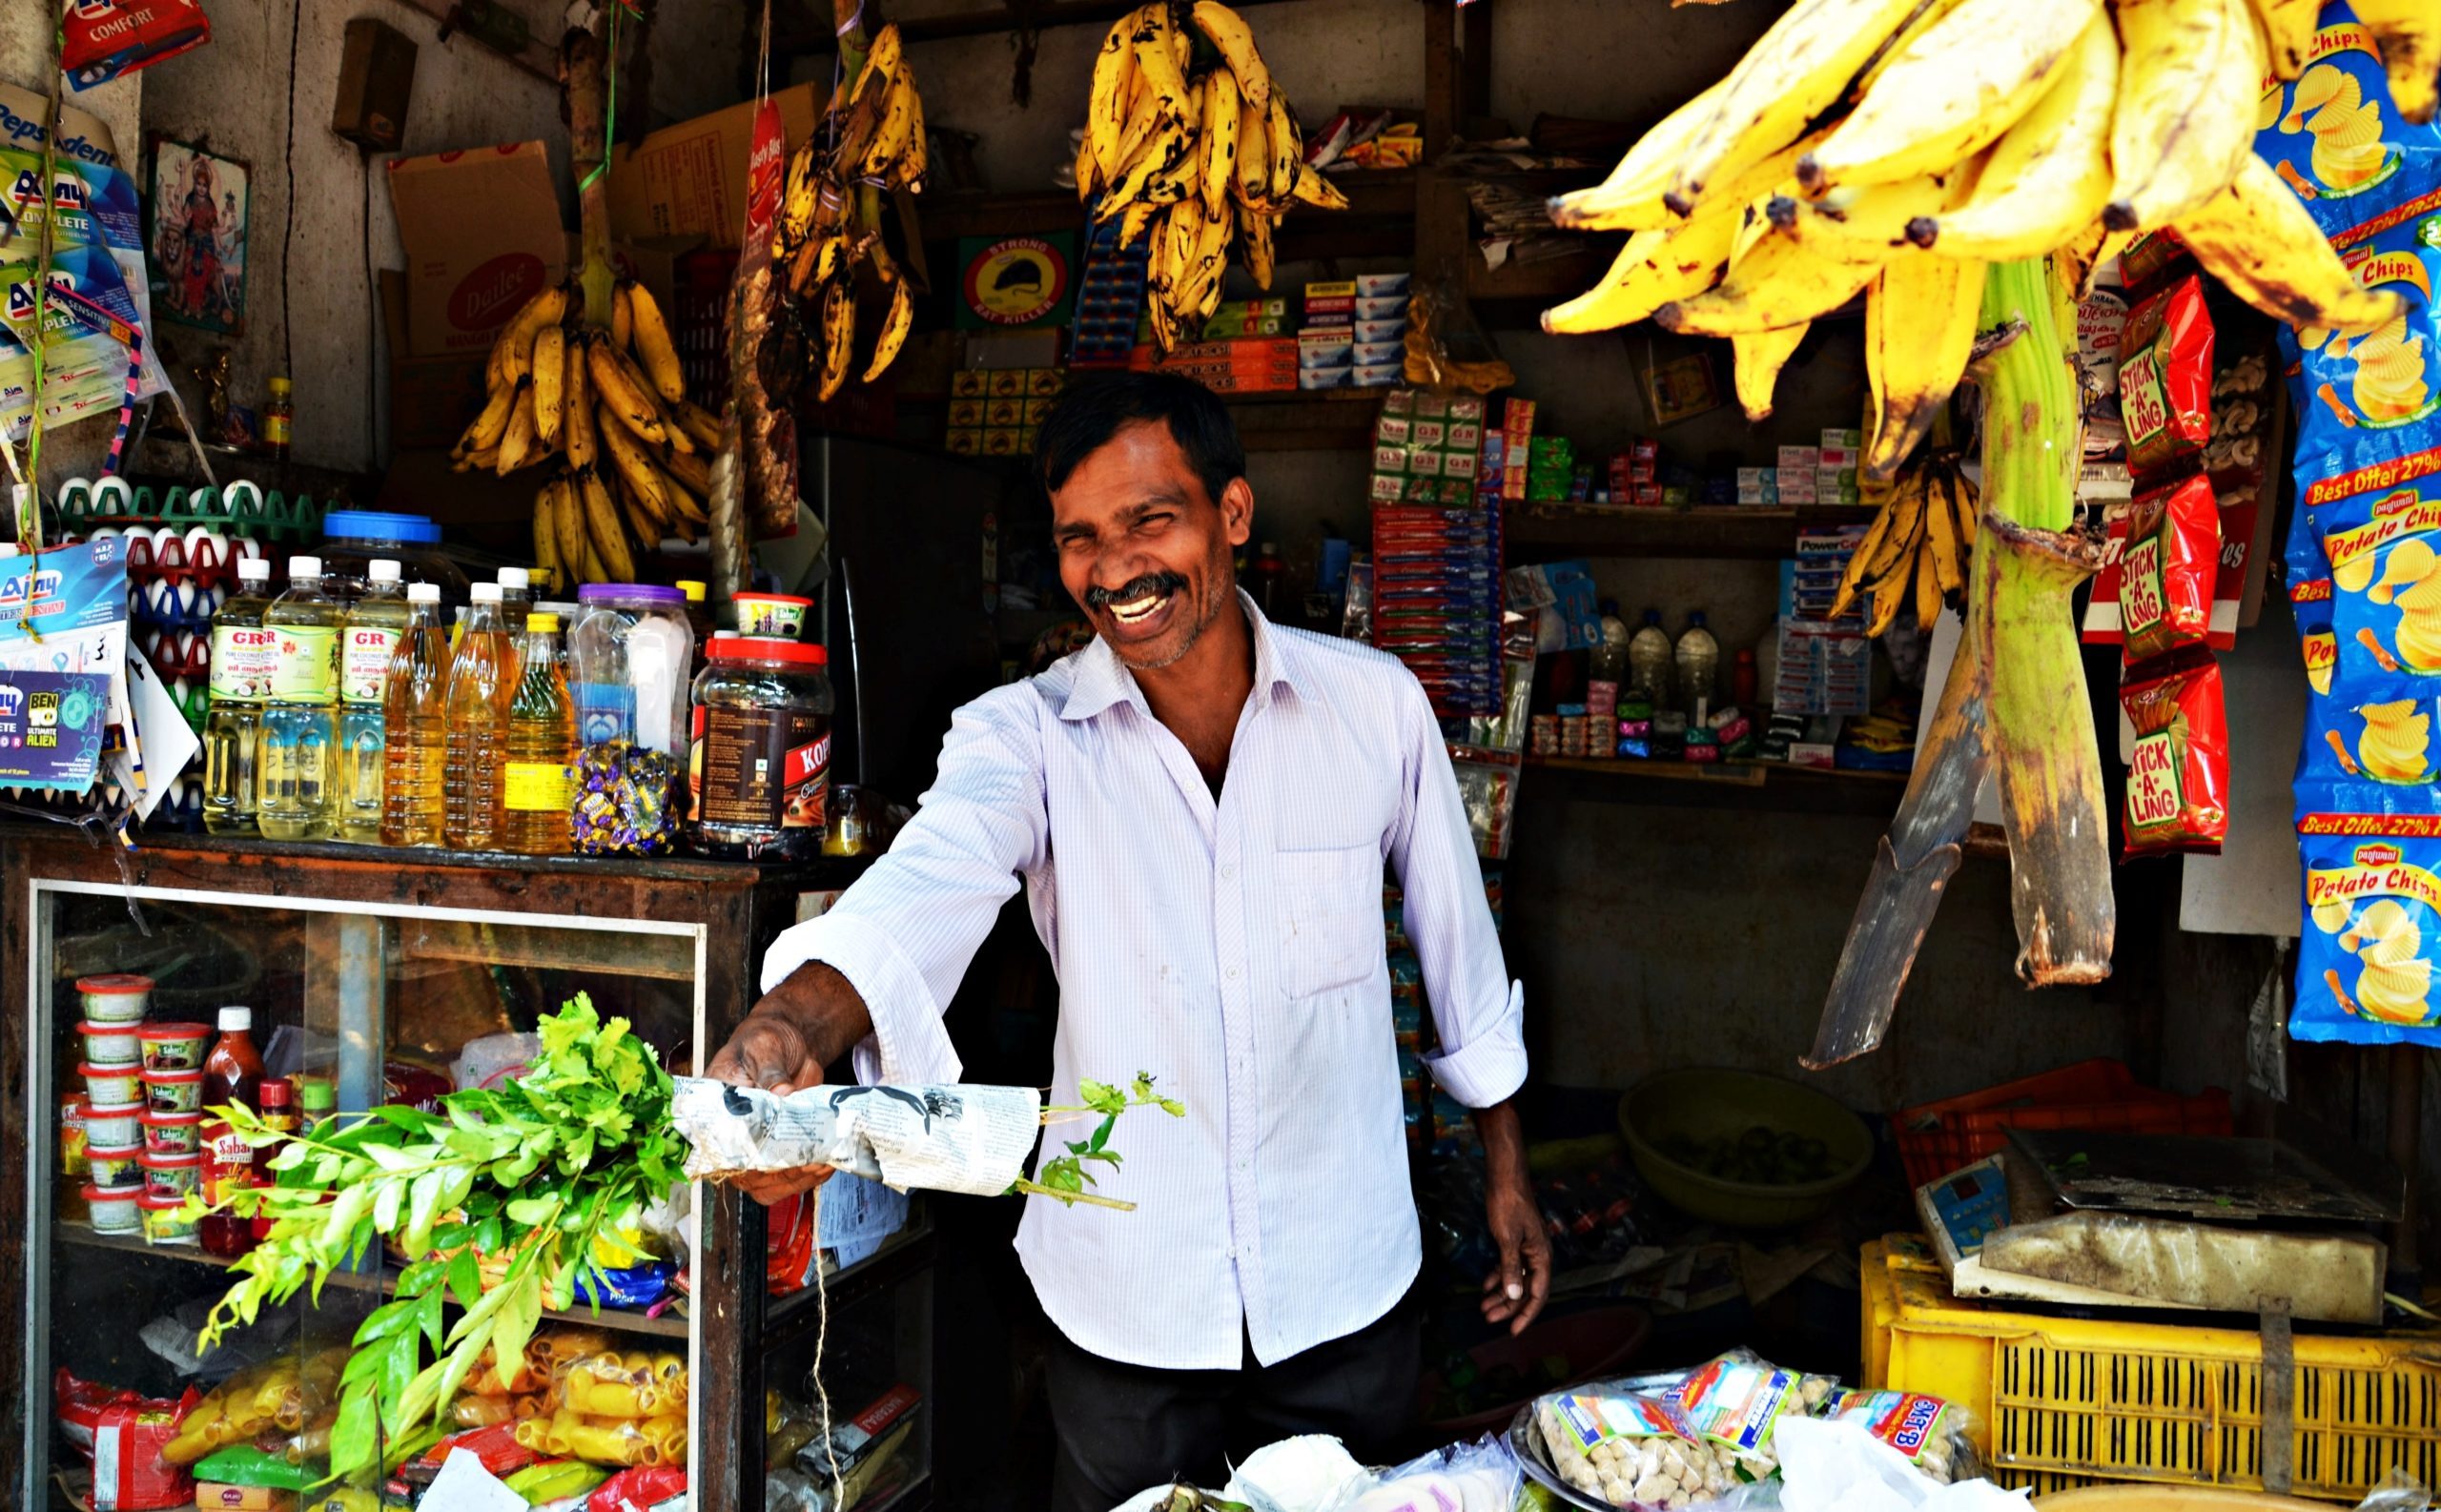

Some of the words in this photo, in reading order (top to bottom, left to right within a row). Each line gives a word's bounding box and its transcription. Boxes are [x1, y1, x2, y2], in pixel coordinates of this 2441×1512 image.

[89, 8, 155, 43] COMFORT
[0, 103, 115, 167] Pepsdent
[988, 237, 1050, 256] STRONG
[2363, 258, 2413, 284] Chips
[68, 297, 112, 327] SENSITIVE
[974, 302, 999, 324] RAT
[2311, 480, 2350, 505] Best
[2354, 467, 2399, 493] Offer
[2401, 450, 2441, 480] 27%
[2330, 521, 2398, 563] Potato
[232, 632, 263, 645] GR
[355, 632, 385, 645] GR
[31, 694, 57, 708] BEN
[29, 709, 57, 726] 10
[27, 727, 57, 737] ULTIMATE
[27, 735, 57, 747] ALIEN
[2303, 816, 2341, 834] Best
[2343, 816, 2384, 834] Offer
[2389, 818, 2430, 835] 27%
[2312, 871, 2379, 900] Potato
[2385, 868, 2438, 902] Chips
